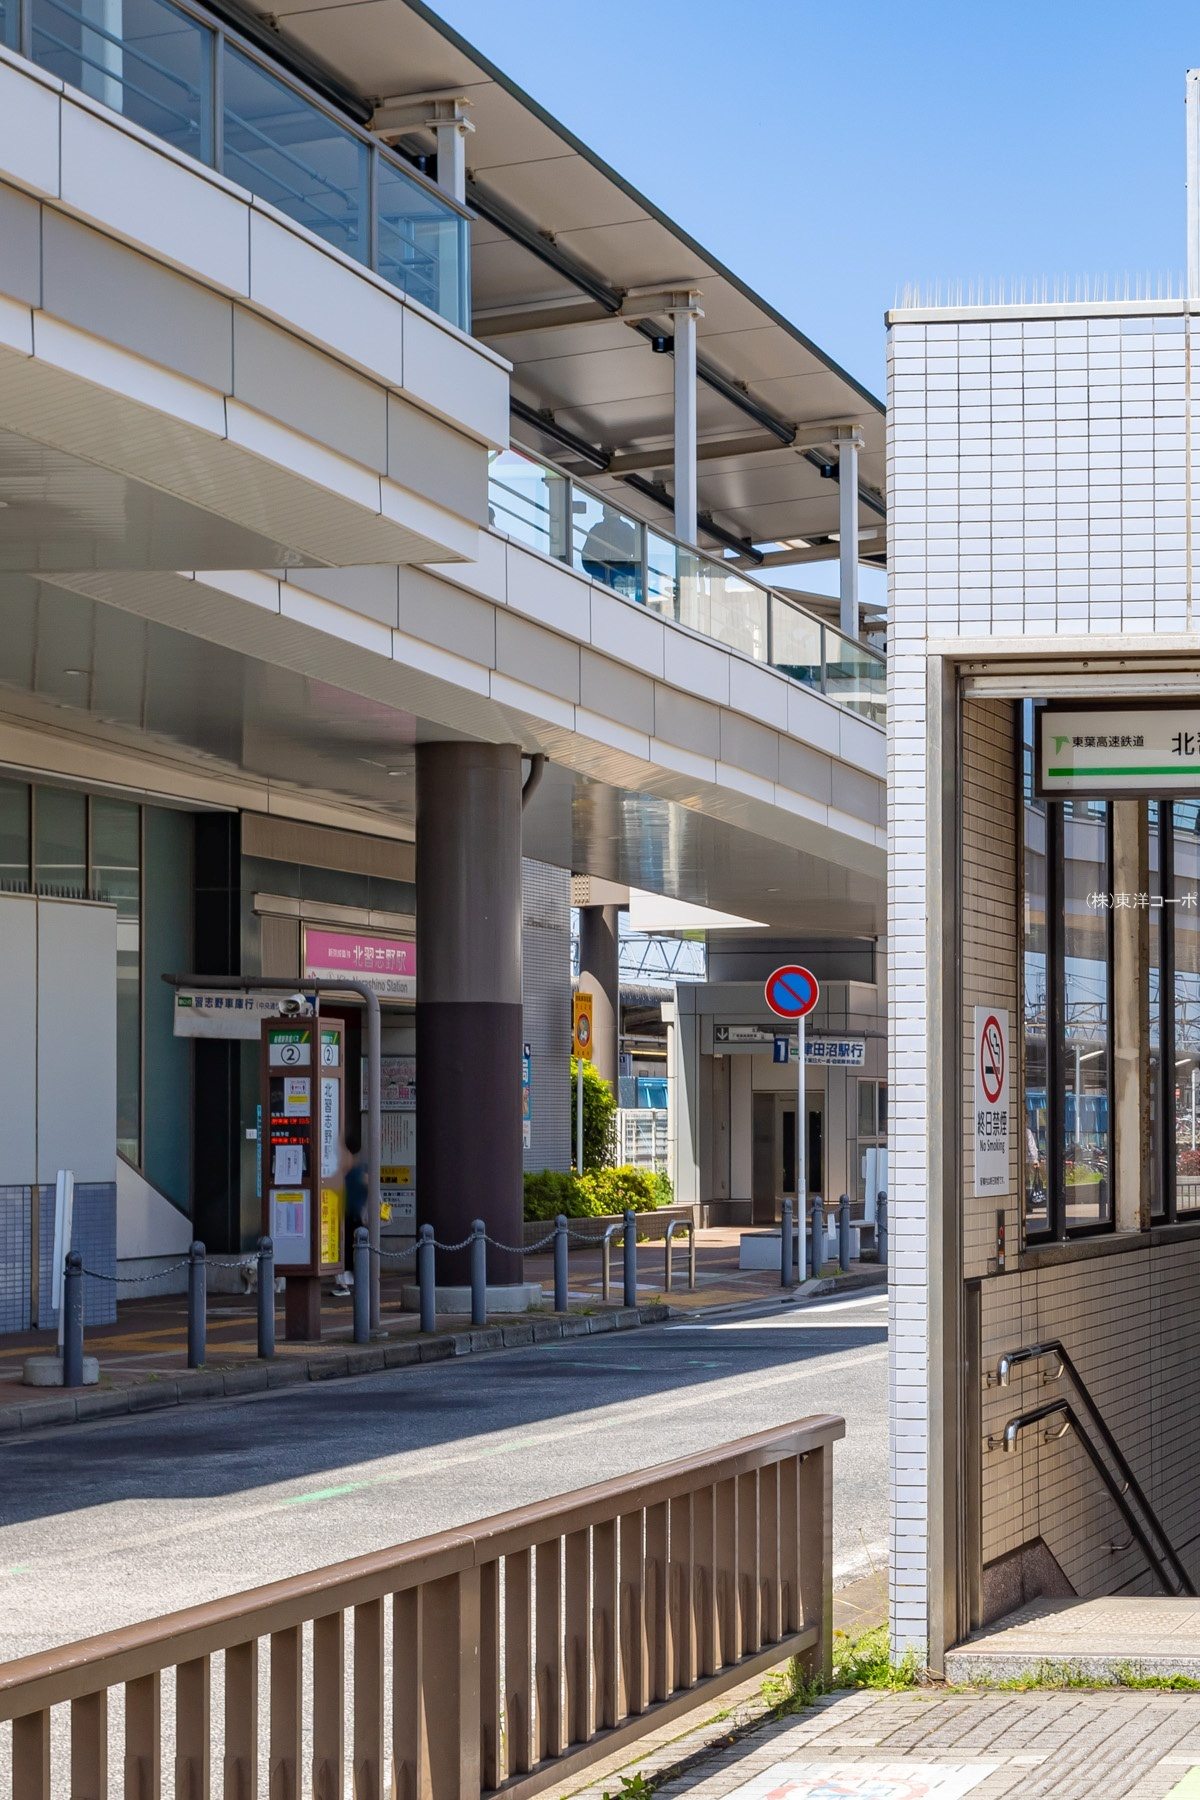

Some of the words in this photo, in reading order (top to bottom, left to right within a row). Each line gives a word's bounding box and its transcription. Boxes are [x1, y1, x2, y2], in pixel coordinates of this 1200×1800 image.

[1071, 735, 1145, 748] 東葉高速鉄道
[353, 944, 407, 971] 北習志野駅
[386, 978, 408, 994] Station
[194, 996, 254, 1010] 習志野車庫行
[777, 1040, 786, 1062] 1
[977, 1110, 1008, 1136] 終日禁煙
[979, 1139, 987, 1152] No
[986, 1138, 1006, 1154] Smoking
